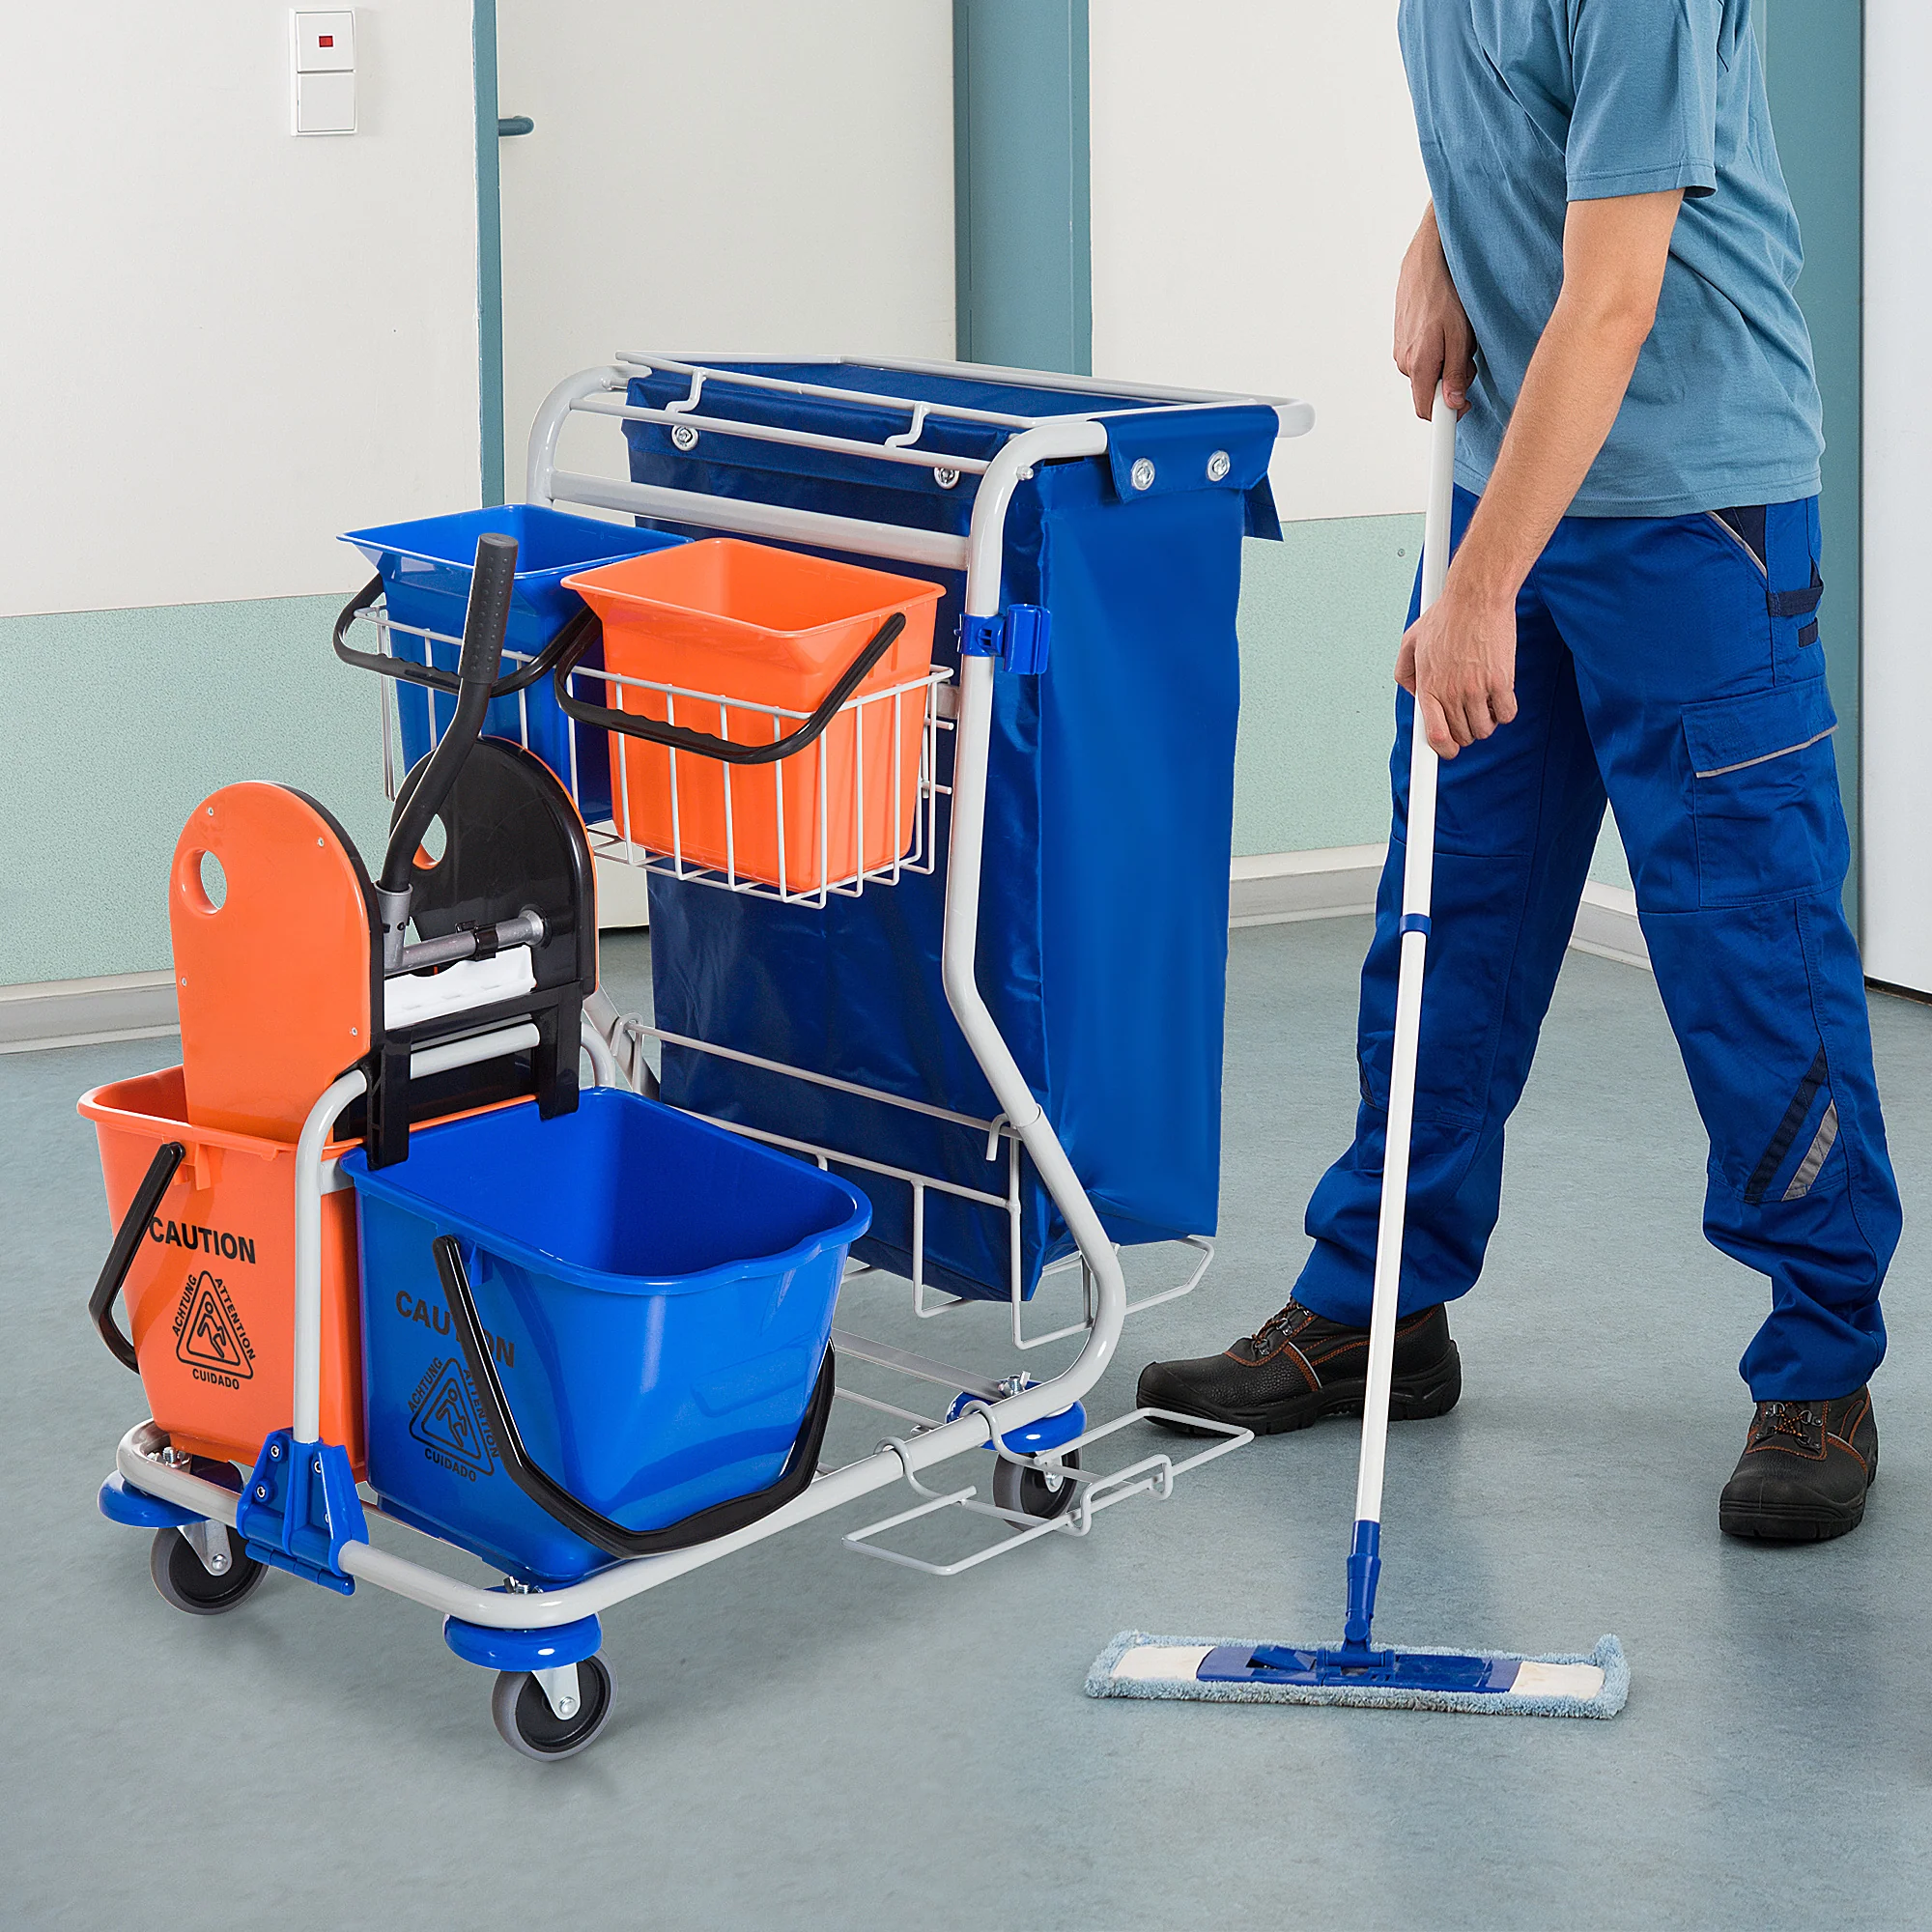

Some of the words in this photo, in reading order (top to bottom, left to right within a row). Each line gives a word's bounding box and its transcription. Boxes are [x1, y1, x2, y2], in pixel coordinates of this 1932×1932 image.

[149, 1217, 256, 1264] CAUTION
[172, 1274, 197, 1336] ACHTUNG
[214, 1278, 255, 1360] ATTENTION
[395, 1291, 515, 1368] CAUN
[192, 1368, 240, 1389] CUIDADO
[407, 1357, 443, 1413] ACHTUNG
[424, 1448, 477, 1483] CUIDADO
